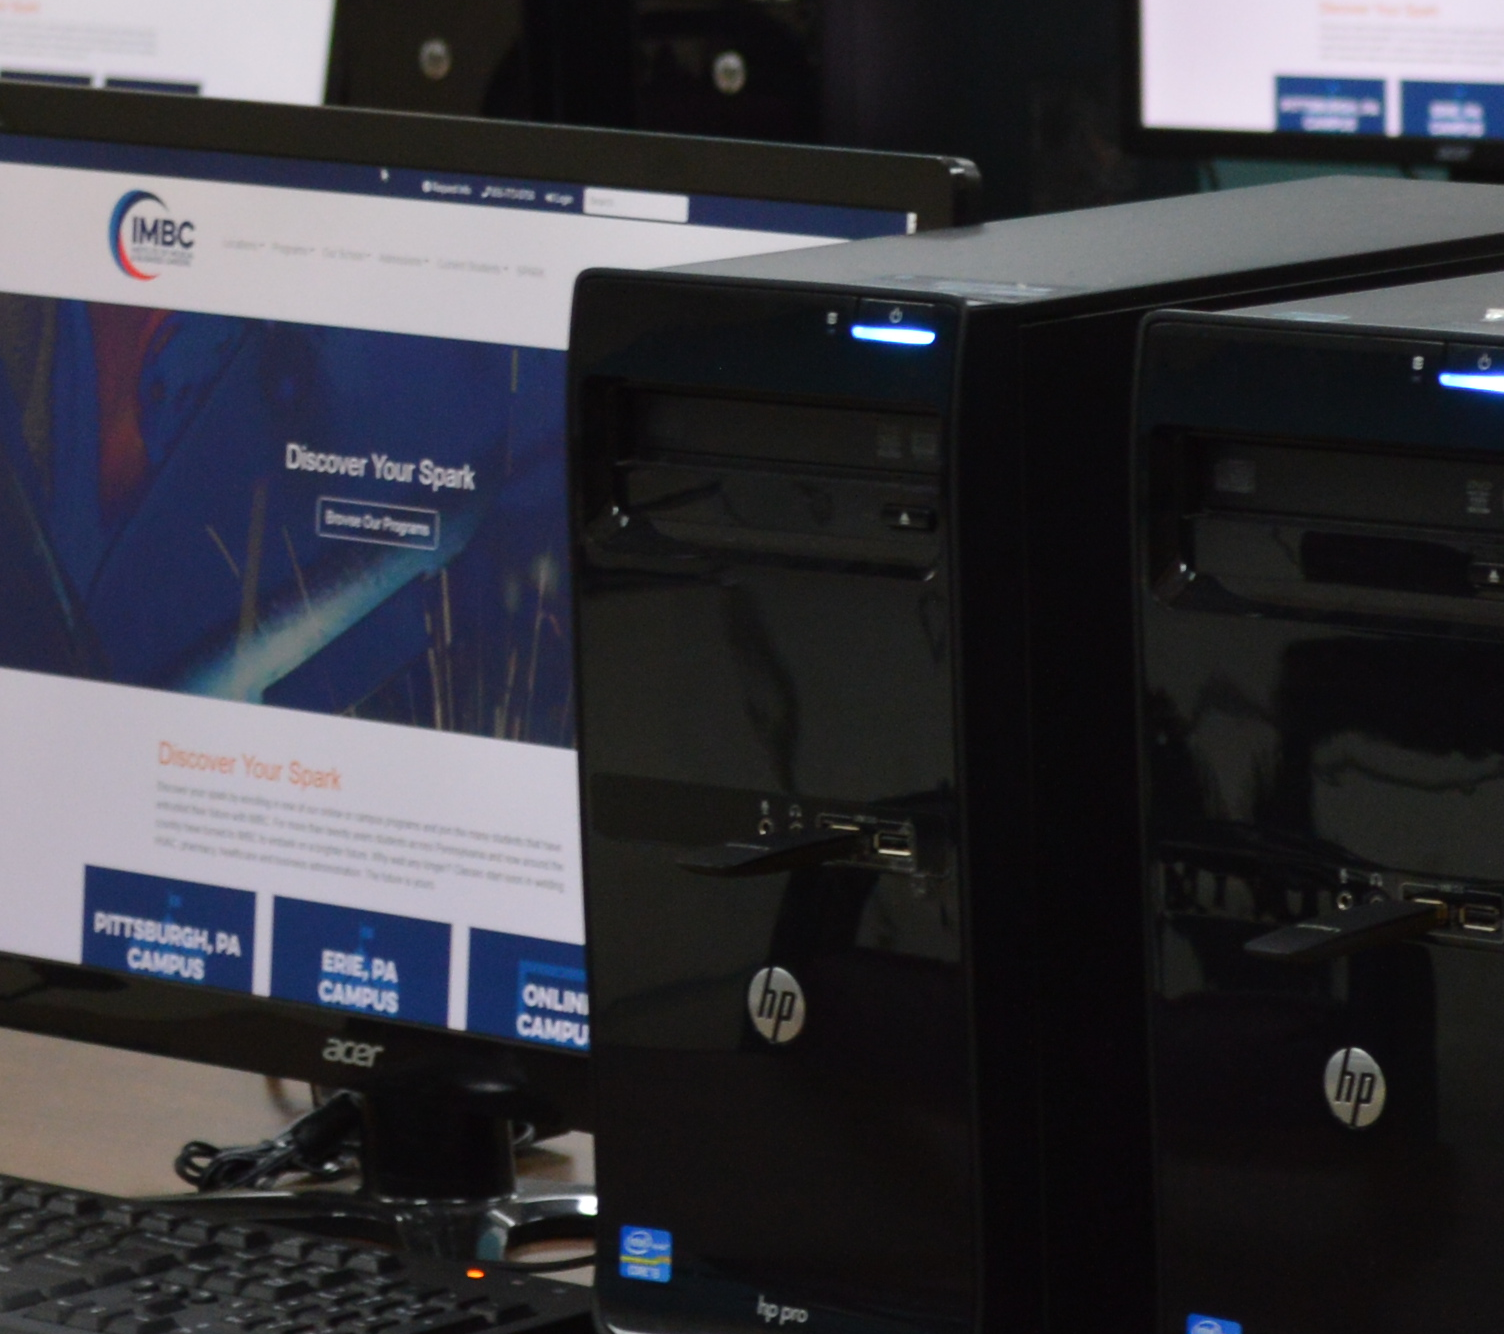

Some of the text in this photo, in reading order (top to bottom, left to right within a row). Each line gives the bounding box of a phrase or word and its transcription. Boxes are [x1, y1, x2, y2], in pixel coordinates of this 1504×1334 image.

[131, 214, 196, 249] IMBC
[285, 442, 476, 492] Discover Your Spark
[157, 740, 343, 792] Discover Your Spark
[94, 911, 241, 957] PITTSBURGH, PA
[127, 947, 205, 980] CAMPUS
[321, 949, 398, 984] ERIE, PA
[317, 979, 399, 1014] CAMPUS
[521, 982, 589, 1016] ONLIN
[515, 1013, 589, 1048] CAMPU
[322, 1037, 385, 1067] acer
[756, 1295, 809, 1327] hp pro
